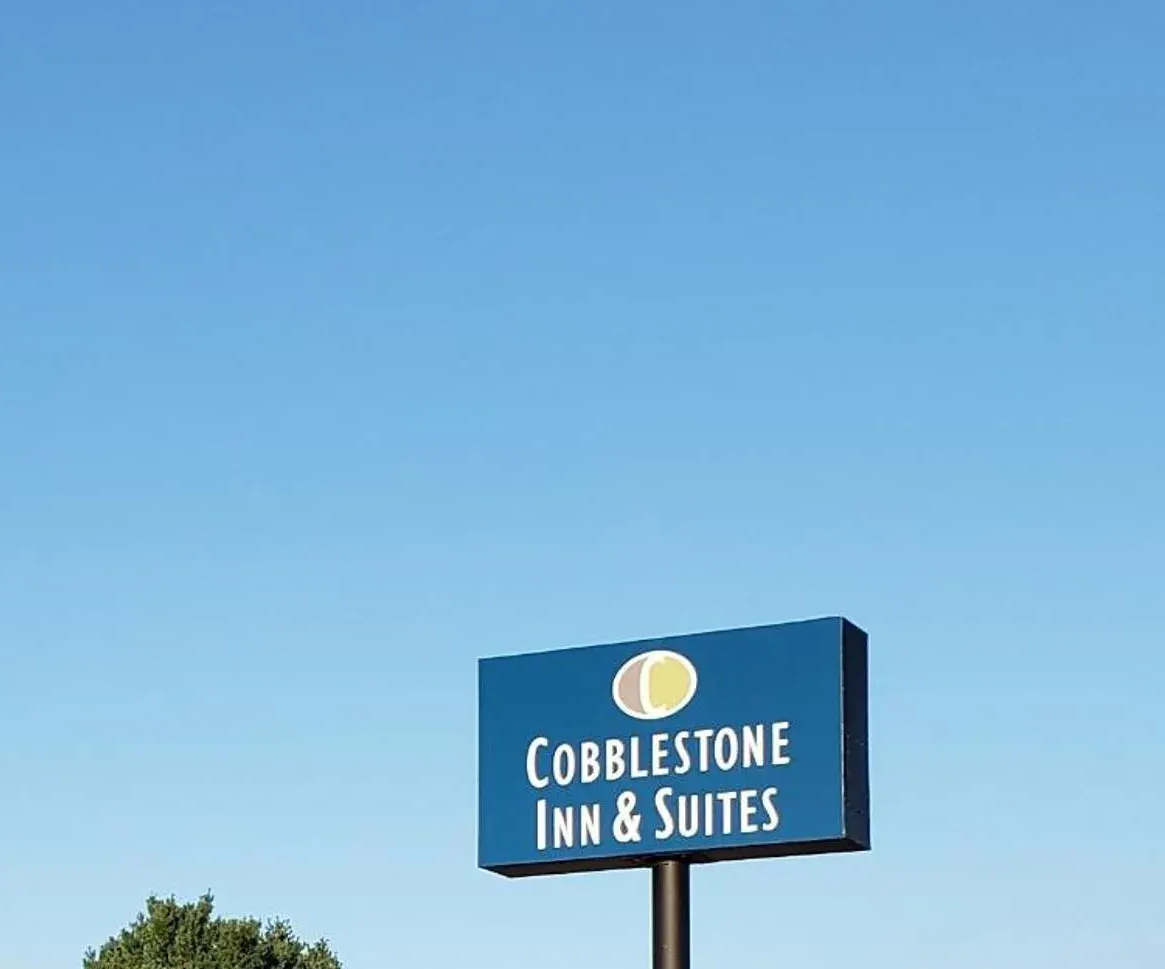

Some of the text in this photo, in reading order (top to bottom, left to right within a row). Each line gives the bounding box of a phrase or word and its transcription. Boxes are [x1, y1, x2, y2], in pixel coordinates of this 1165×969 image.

[526, 720, 791, 789] COBBLESTONE
[536, 786, 780, 851] INN & SUITES
